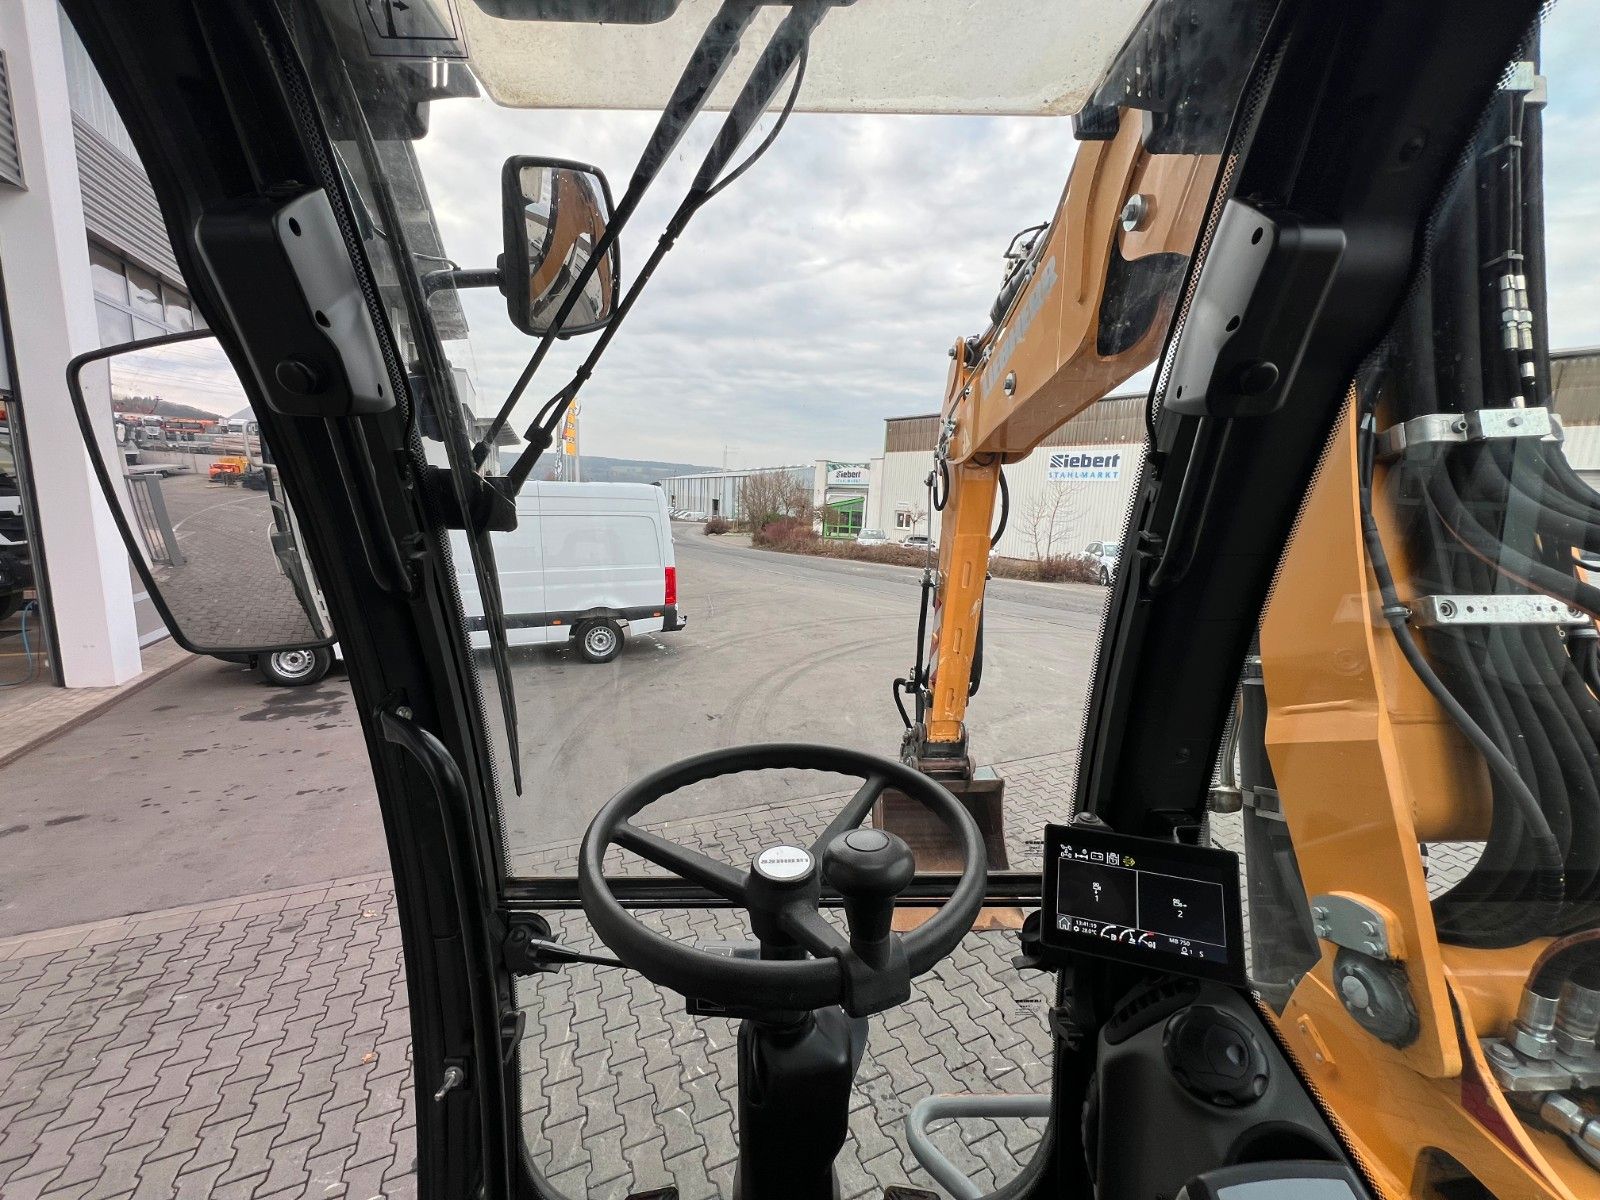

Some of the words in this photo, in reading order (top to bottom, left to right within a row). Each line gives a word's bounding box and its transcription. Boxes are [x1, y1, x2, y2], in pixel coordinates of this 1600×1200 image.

[1050, 454, 1120, 468] Siebert
[836, 470, 861, 478] Siebert
[1177, 910, 1183, 918] 2
